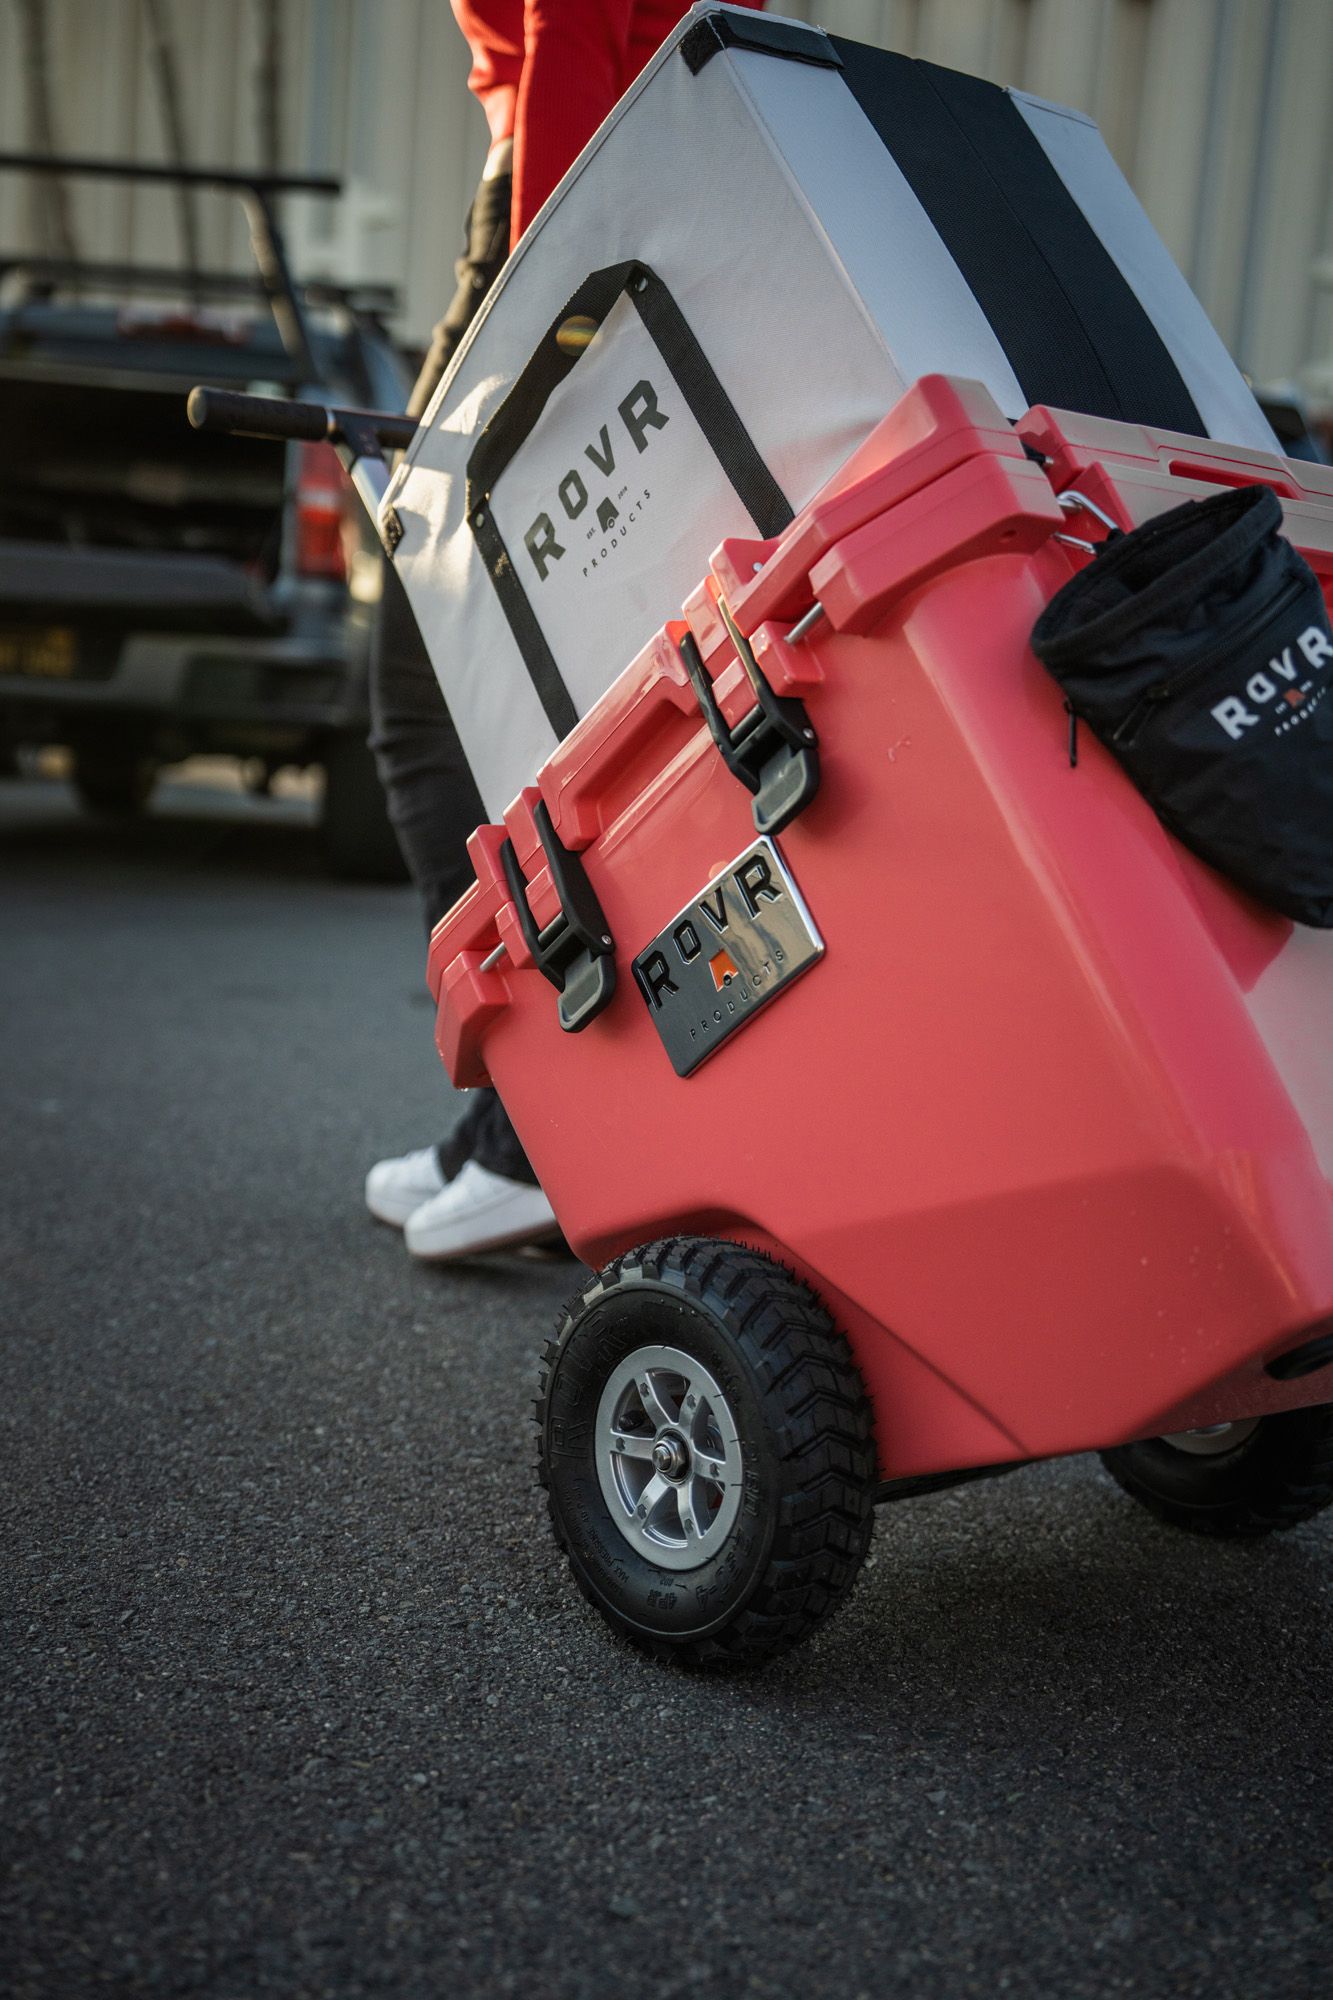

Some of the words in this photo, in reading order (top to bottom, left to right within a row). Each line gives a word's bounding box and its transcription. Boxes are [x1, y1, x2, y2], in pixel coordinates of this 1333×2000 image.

[523, 379, 670, 582] ROVR
[583, 489, 651, 577] PRODUCTS
[1210, 626, 1333, 740] ROVR
[637, 854, 784, 1013] ROVR
[690, 950, 784, 1042] PRODUCTS
